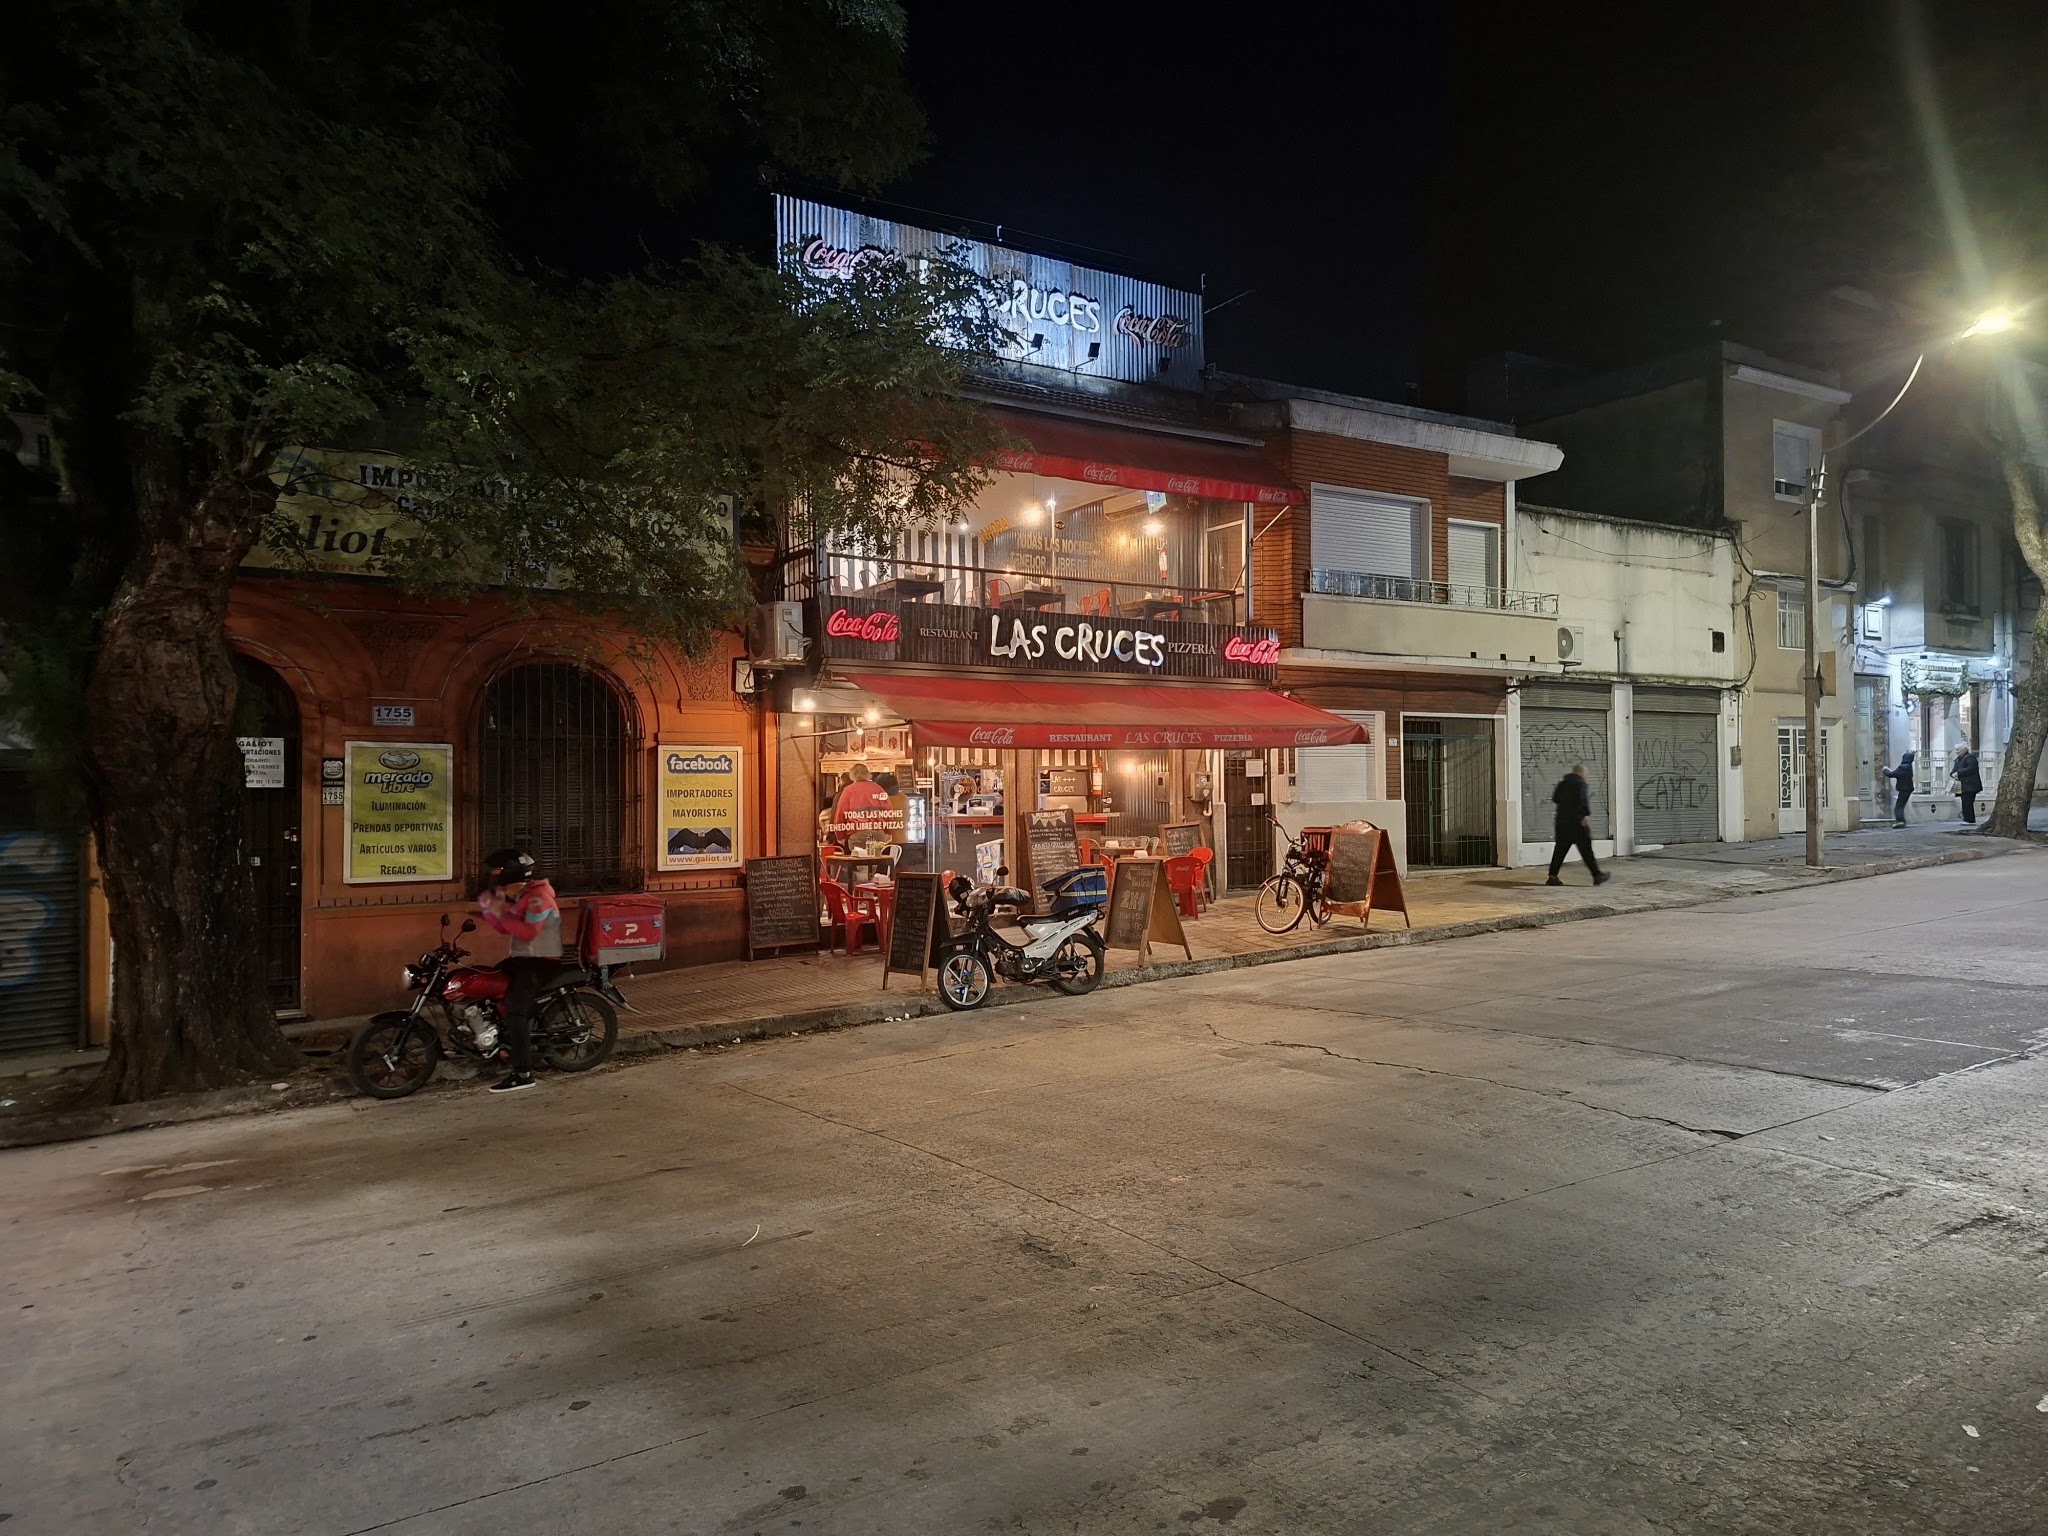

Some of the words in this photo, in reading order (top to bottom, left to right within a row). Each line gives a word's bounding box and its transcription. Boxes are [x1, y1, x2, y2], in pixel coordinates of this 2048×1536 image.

[1168, 478, 1199, 495] Coca-Cola
[827, 608, 900, 642] Coca-Cola
[919, 627, 979, 641] RESTAURANT
[990, 614, 1048, 661] LAS
[1054, 622, 1166, 667] CRUCES
[1224, 635, 1280, 666] Coca-Cola
[375, 707, 412, 718] 1755
[969, 726, 1015, 746] Coca-Cola
[1049, 732, 1113, 743] RESTAURANT
[1123, 731, 1150, 745] LAS
[1153, 731, 1203, 745] CRUCES
[1294, 728, 1329, 746] Coca-Cola
[669, 756, 730, 771] facebook
[364, 771, 434, 785] mercado
[381, 781, 417, 794] Libre
[323, 792, 344, 800] 1755
[666, 789, 734, 799] IMPORTADORES
[672, 808, 728, 818] MAYORISTAS
[844, 811, 865, 819] TODAS
[866, 811, 878, 819] LAS
[879, 809, 904, 818] NOCHES
[825, 822, 856, 832] TENEDOR
[856, 821, 873, 831] LIBRE
[873, 821, 882, 830] DE
[883, 820, 904, 830] PIZZAS
[668, 854, 734, 864] www.galiot.uy
[761, 858, 803, 869] MILANESAS
